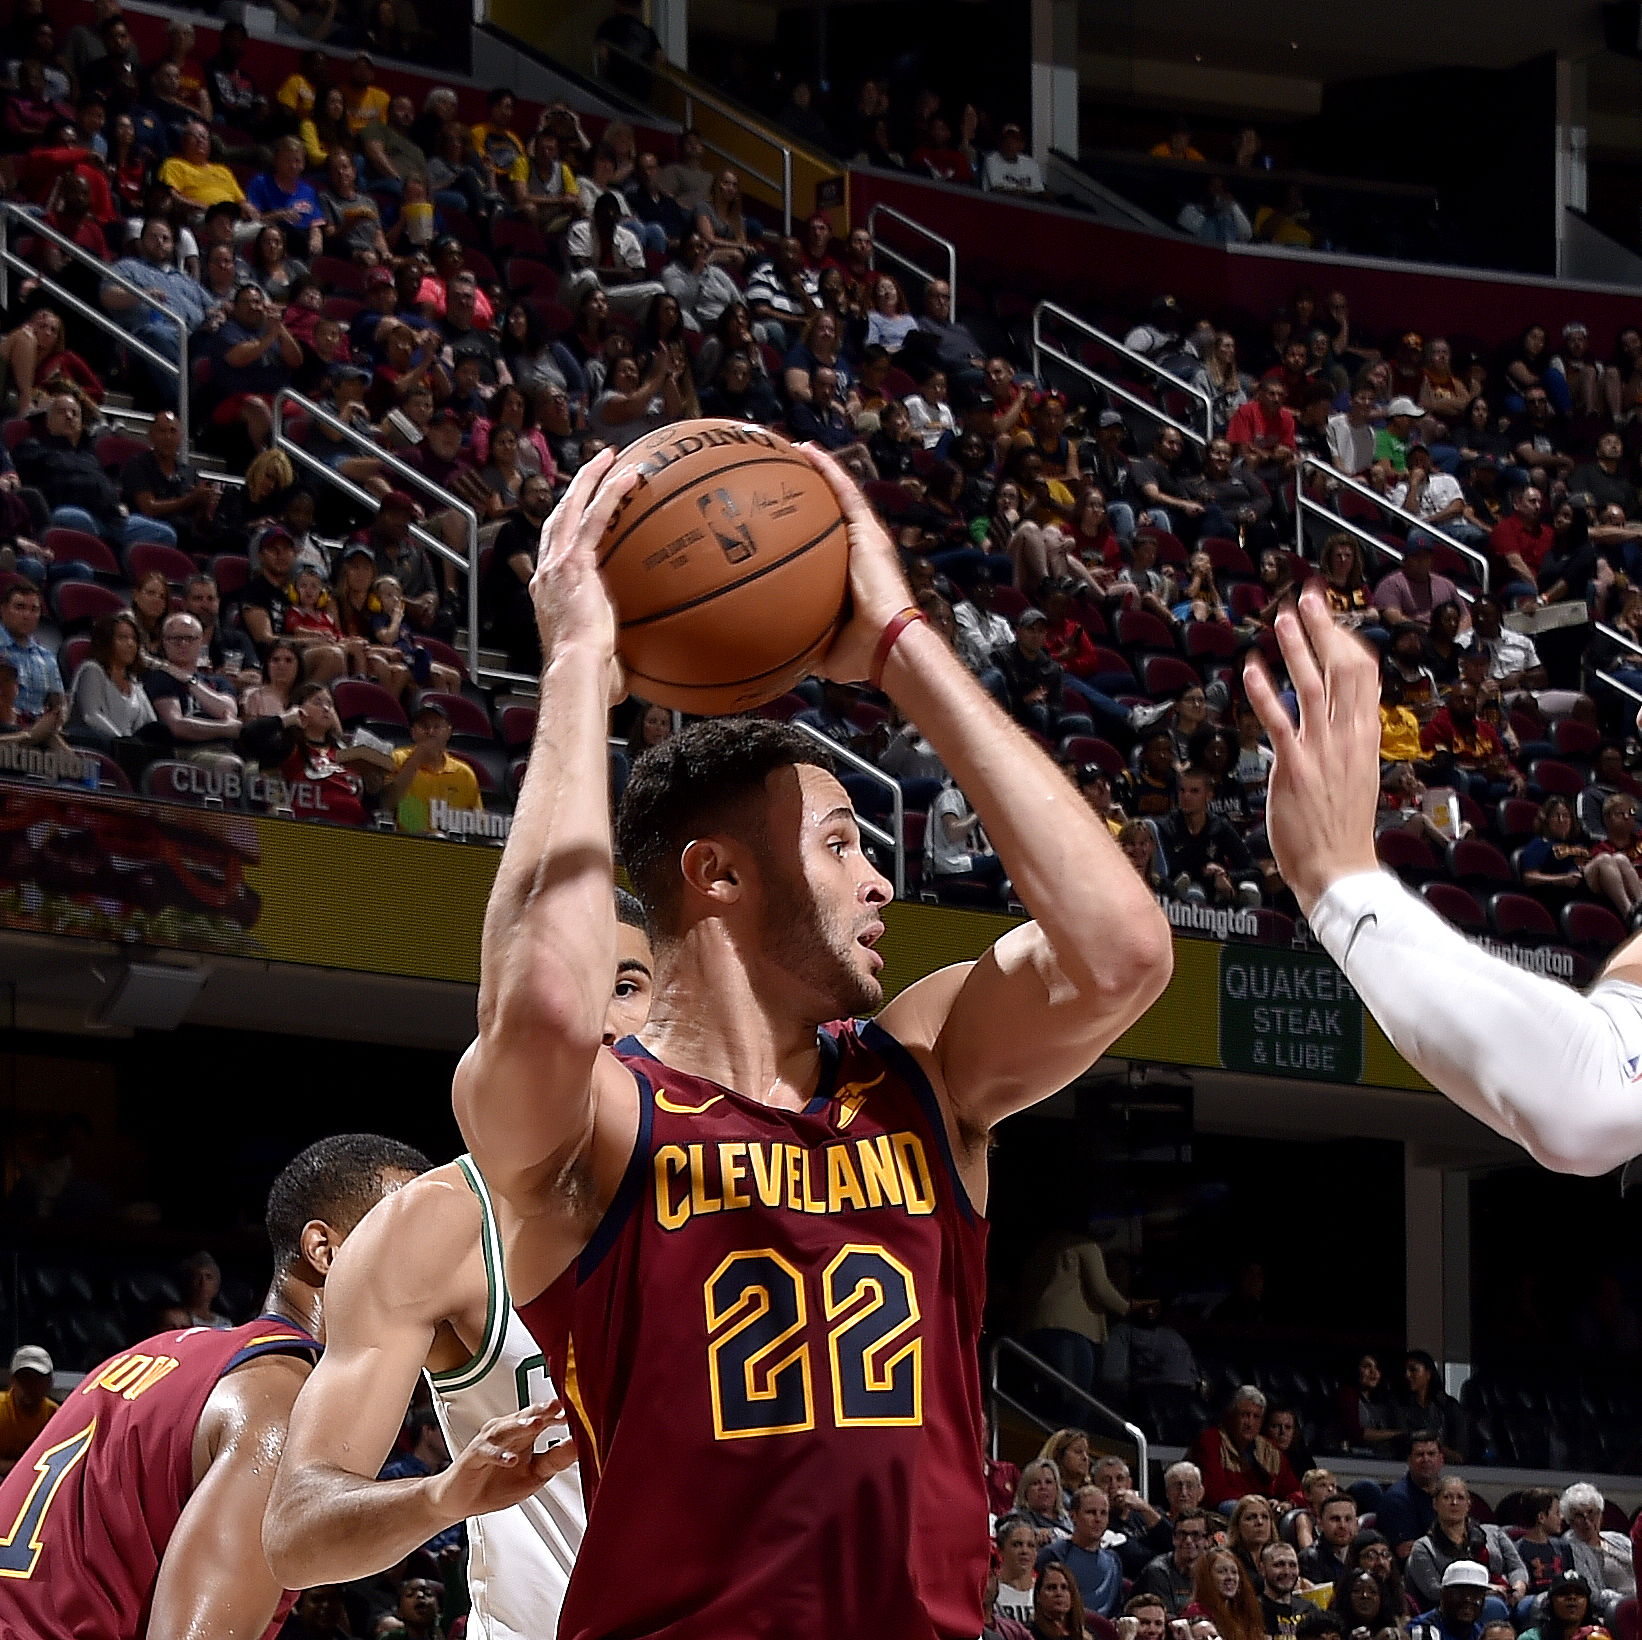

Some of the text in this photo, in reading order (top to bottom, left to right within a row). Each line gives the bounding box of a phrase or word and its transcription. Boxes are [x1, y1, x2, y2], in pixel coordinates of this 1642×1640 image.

[169, 764, 331, 812] CLUB LEVEL
[1252, 1005, 1343, 1038] STEAK
[1252, 1042, 1337, 1072] & LUBE
[653, 1129, 939, 1231] CLEVELAND
[703, 1242, 924, 1442] 22
